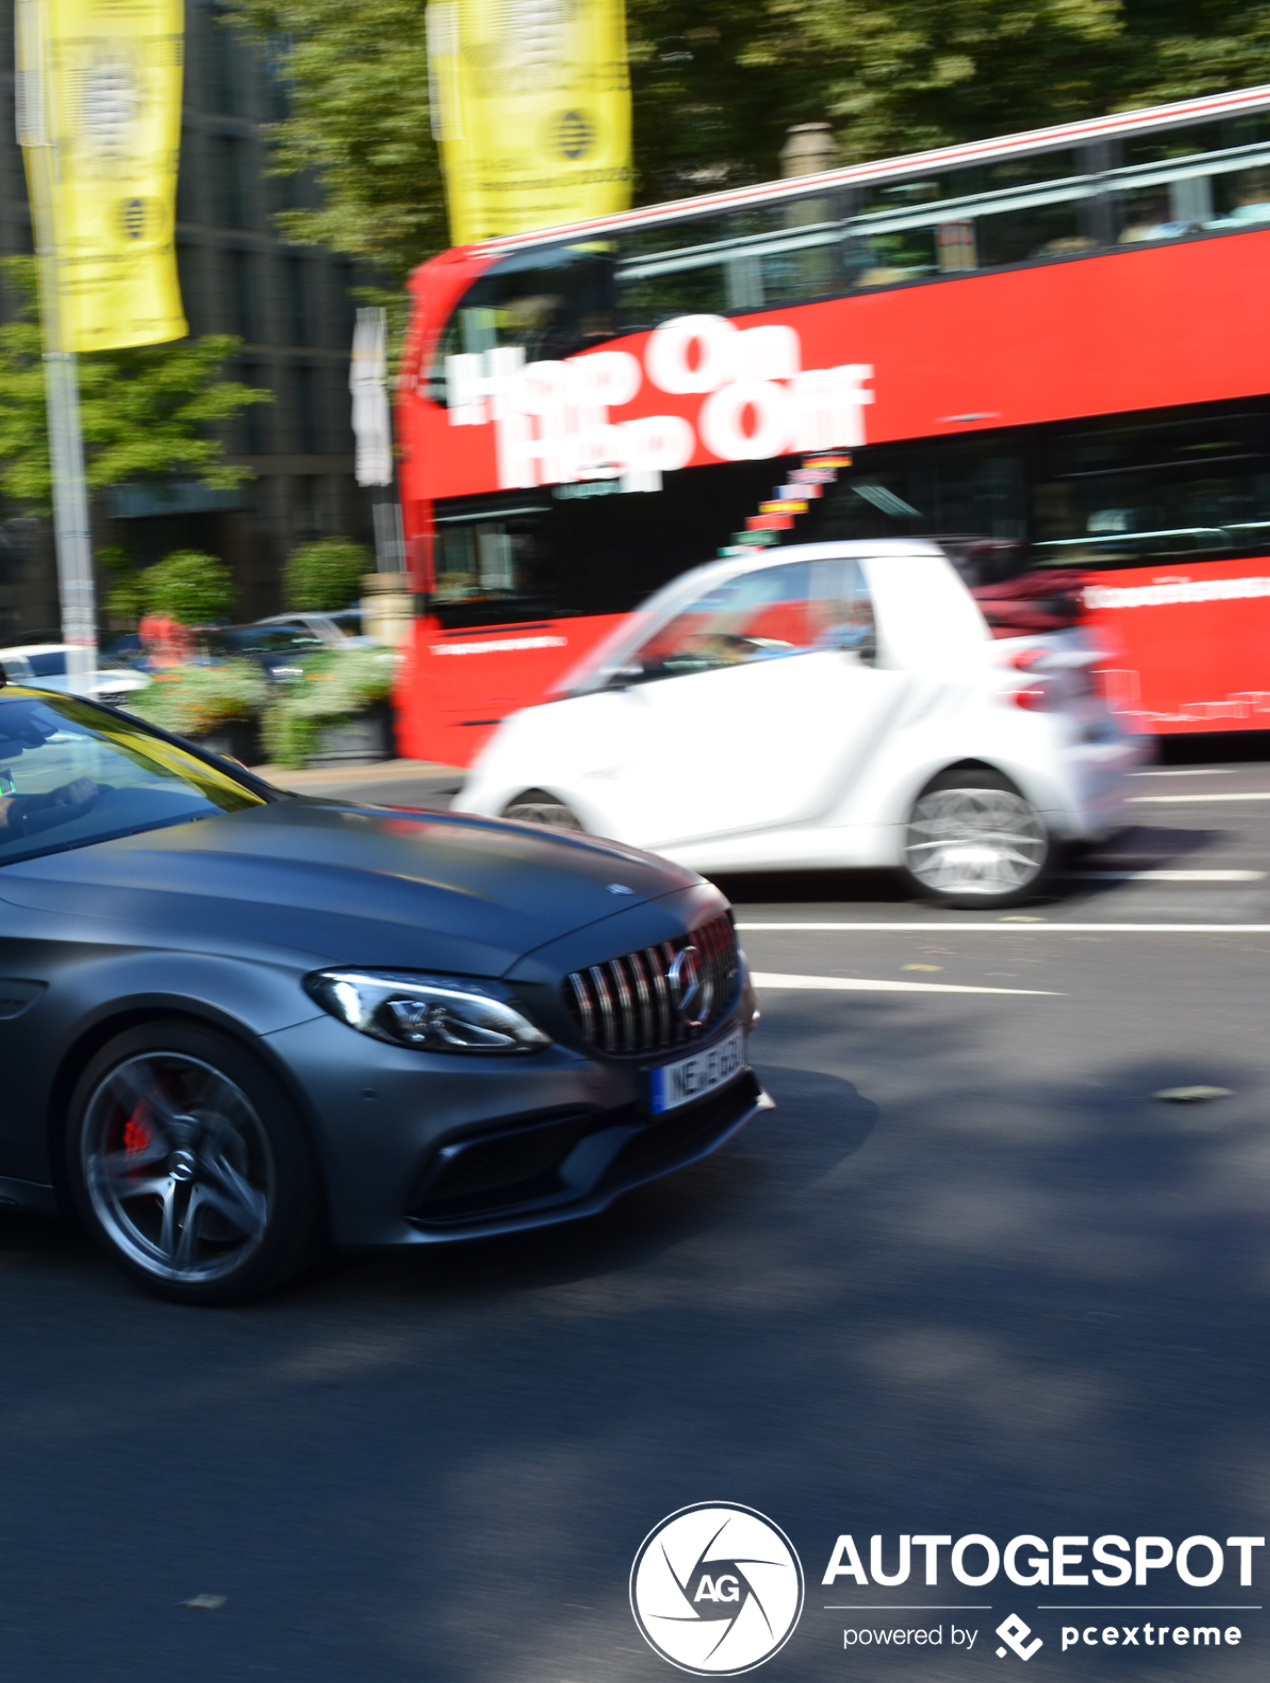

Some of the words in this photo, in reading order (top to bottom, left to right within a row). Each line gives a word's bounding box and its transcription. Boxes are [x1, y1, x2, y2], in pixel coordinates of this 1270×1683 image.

[447, 346, 641, 425] Hop
[644, 314, 800, 394] On
[495, 404, 696, 492] Hop
[699, 363, 876, 460] Off
